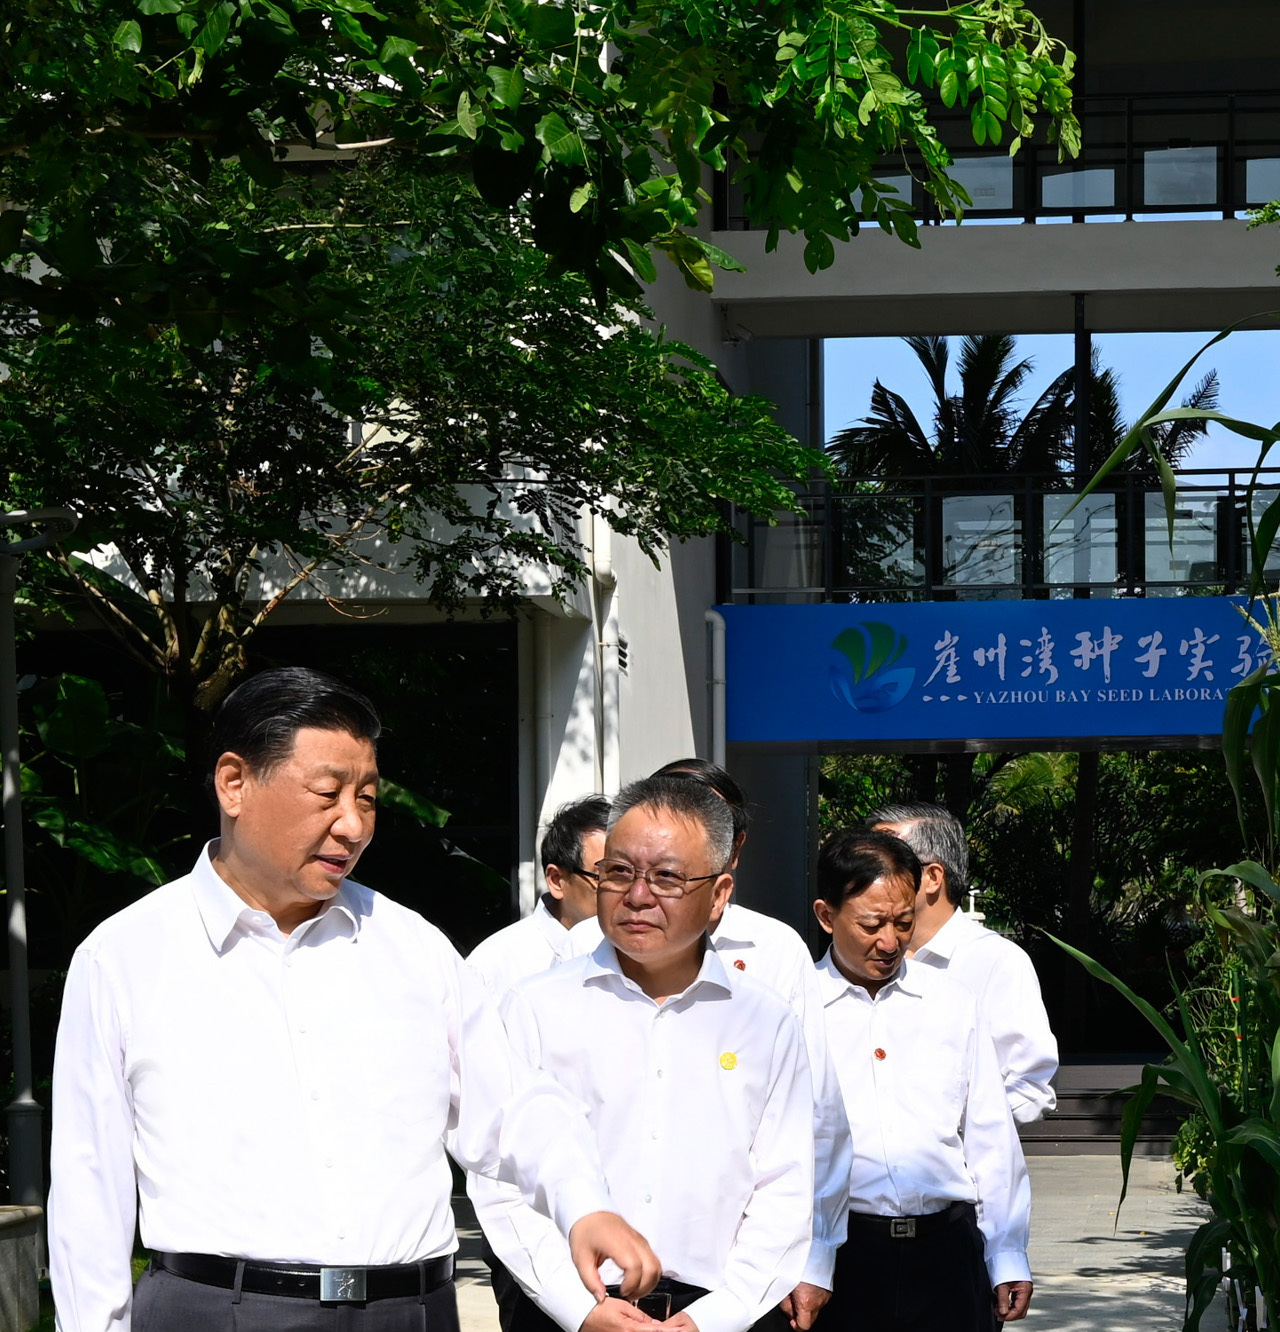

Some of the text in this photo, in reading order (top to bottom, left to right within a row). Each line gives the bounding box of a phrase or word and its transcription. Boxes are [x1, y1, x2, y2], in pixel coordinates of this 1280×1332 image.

[974, 688, 1229, 704] YAZHOU BAY SEED LABORA
